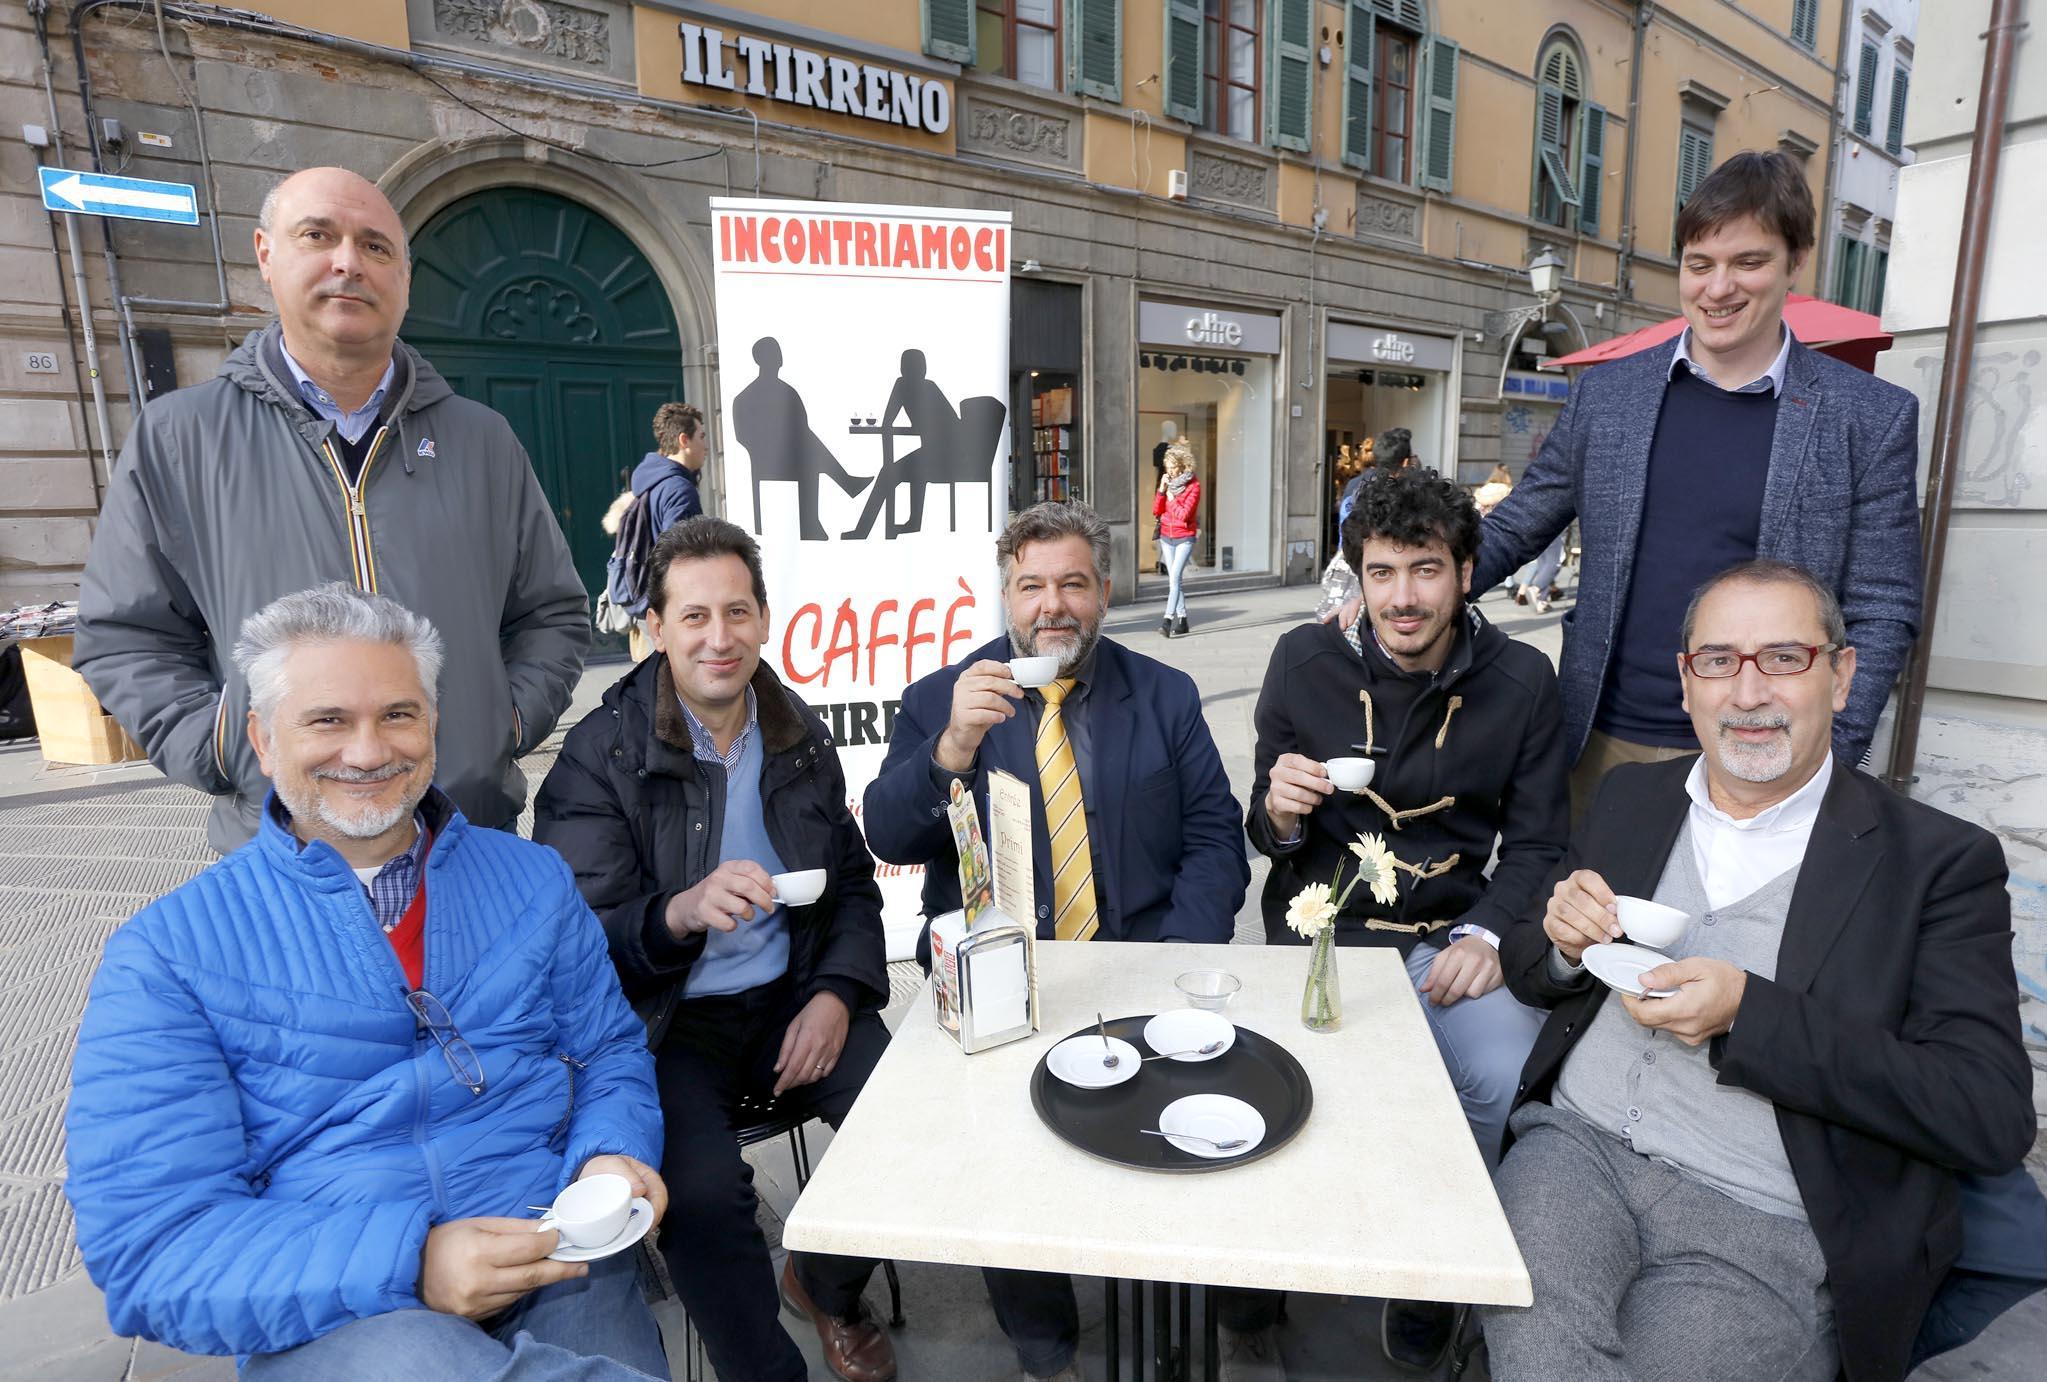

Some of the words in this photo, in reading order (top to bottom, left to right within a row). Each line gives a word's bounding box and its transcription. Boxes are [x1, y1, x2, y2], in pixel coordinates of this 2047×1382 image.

[679, 22, 735, 90] IL
[736, 35, 950, 134] TIRRENO
[720, 215, 1005, 272] INCONTRIAMOCI
[29, 355, 52, 369] 86
[782, 575, 976, 688] CAFFÈ
